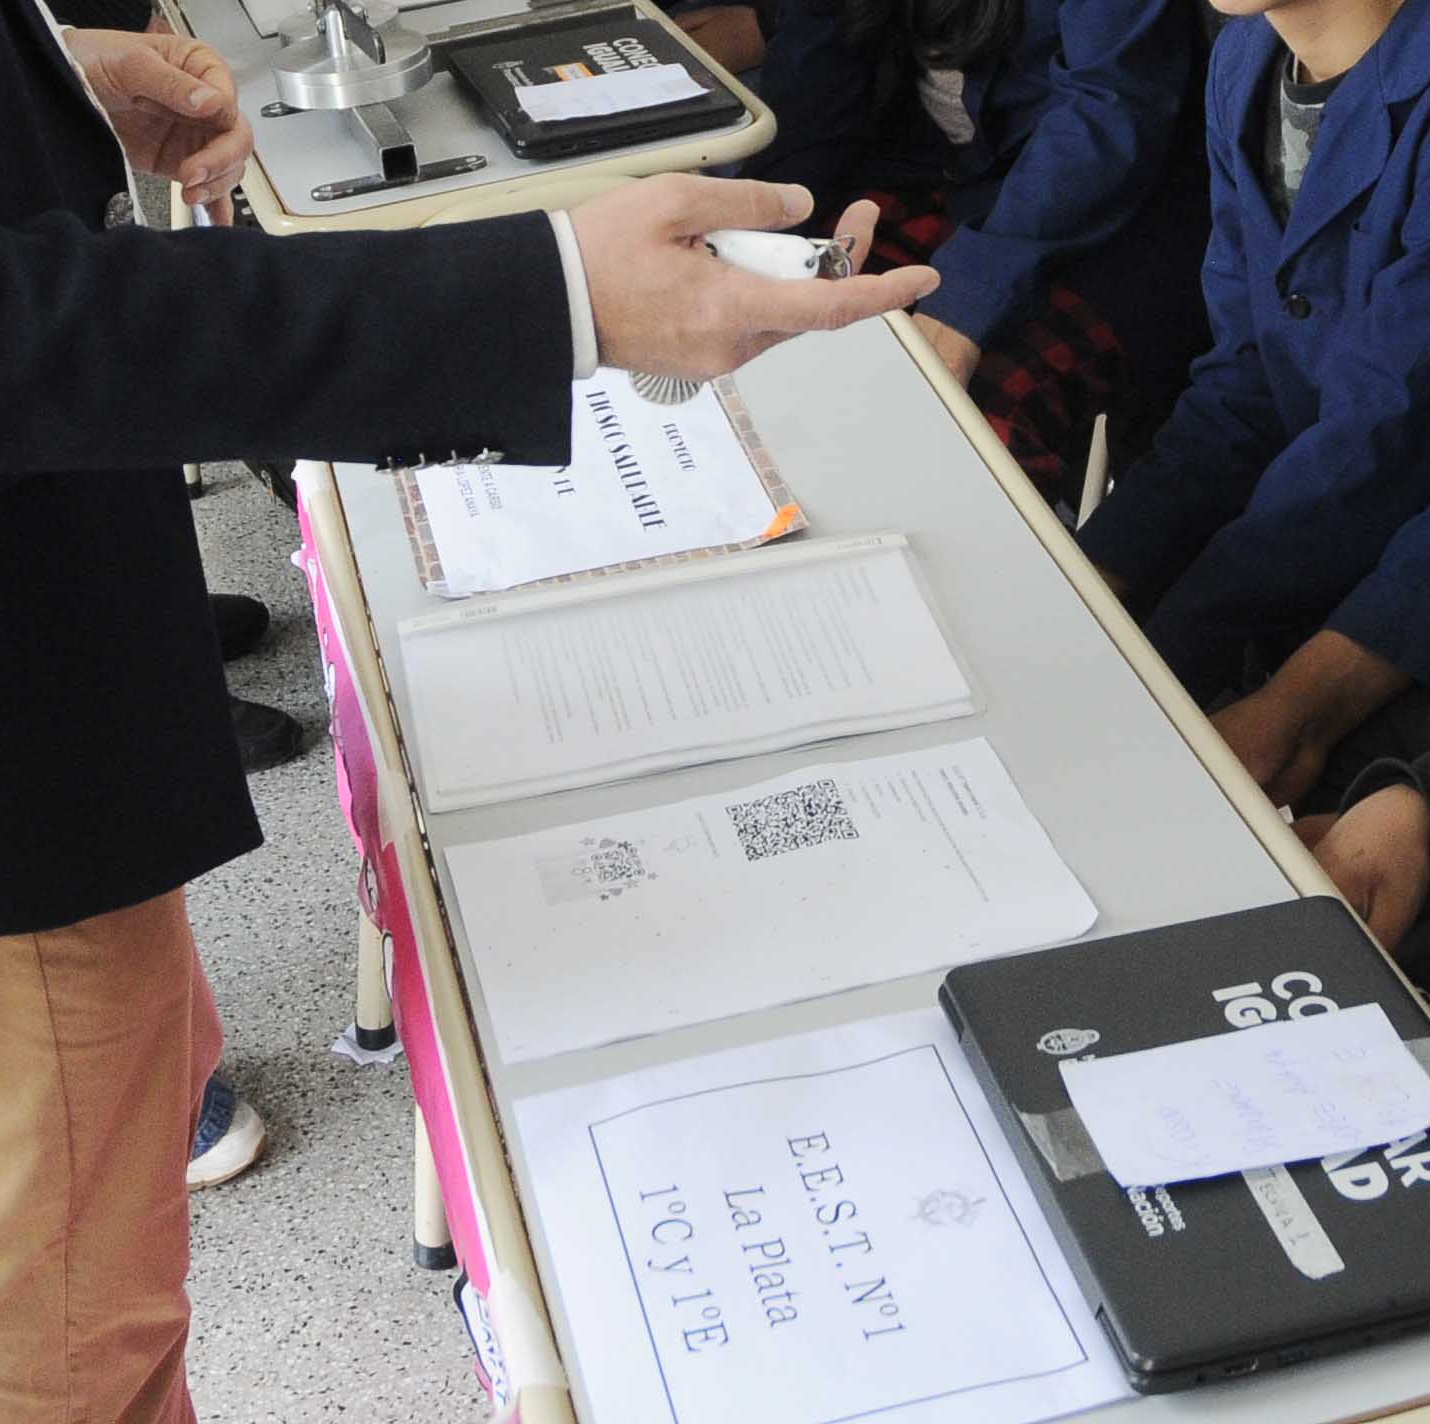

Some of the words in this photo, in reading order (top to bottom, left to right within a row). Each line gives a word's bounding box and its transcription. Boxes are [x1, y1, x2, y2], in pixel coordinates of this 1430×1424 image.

[723, 1185, 765, 1231] La
[787, 1131, 872, 1268] E.E.S.T.
[647, 1255, 693, 1273] y
[741, 1237, 800, 1328] Plata
